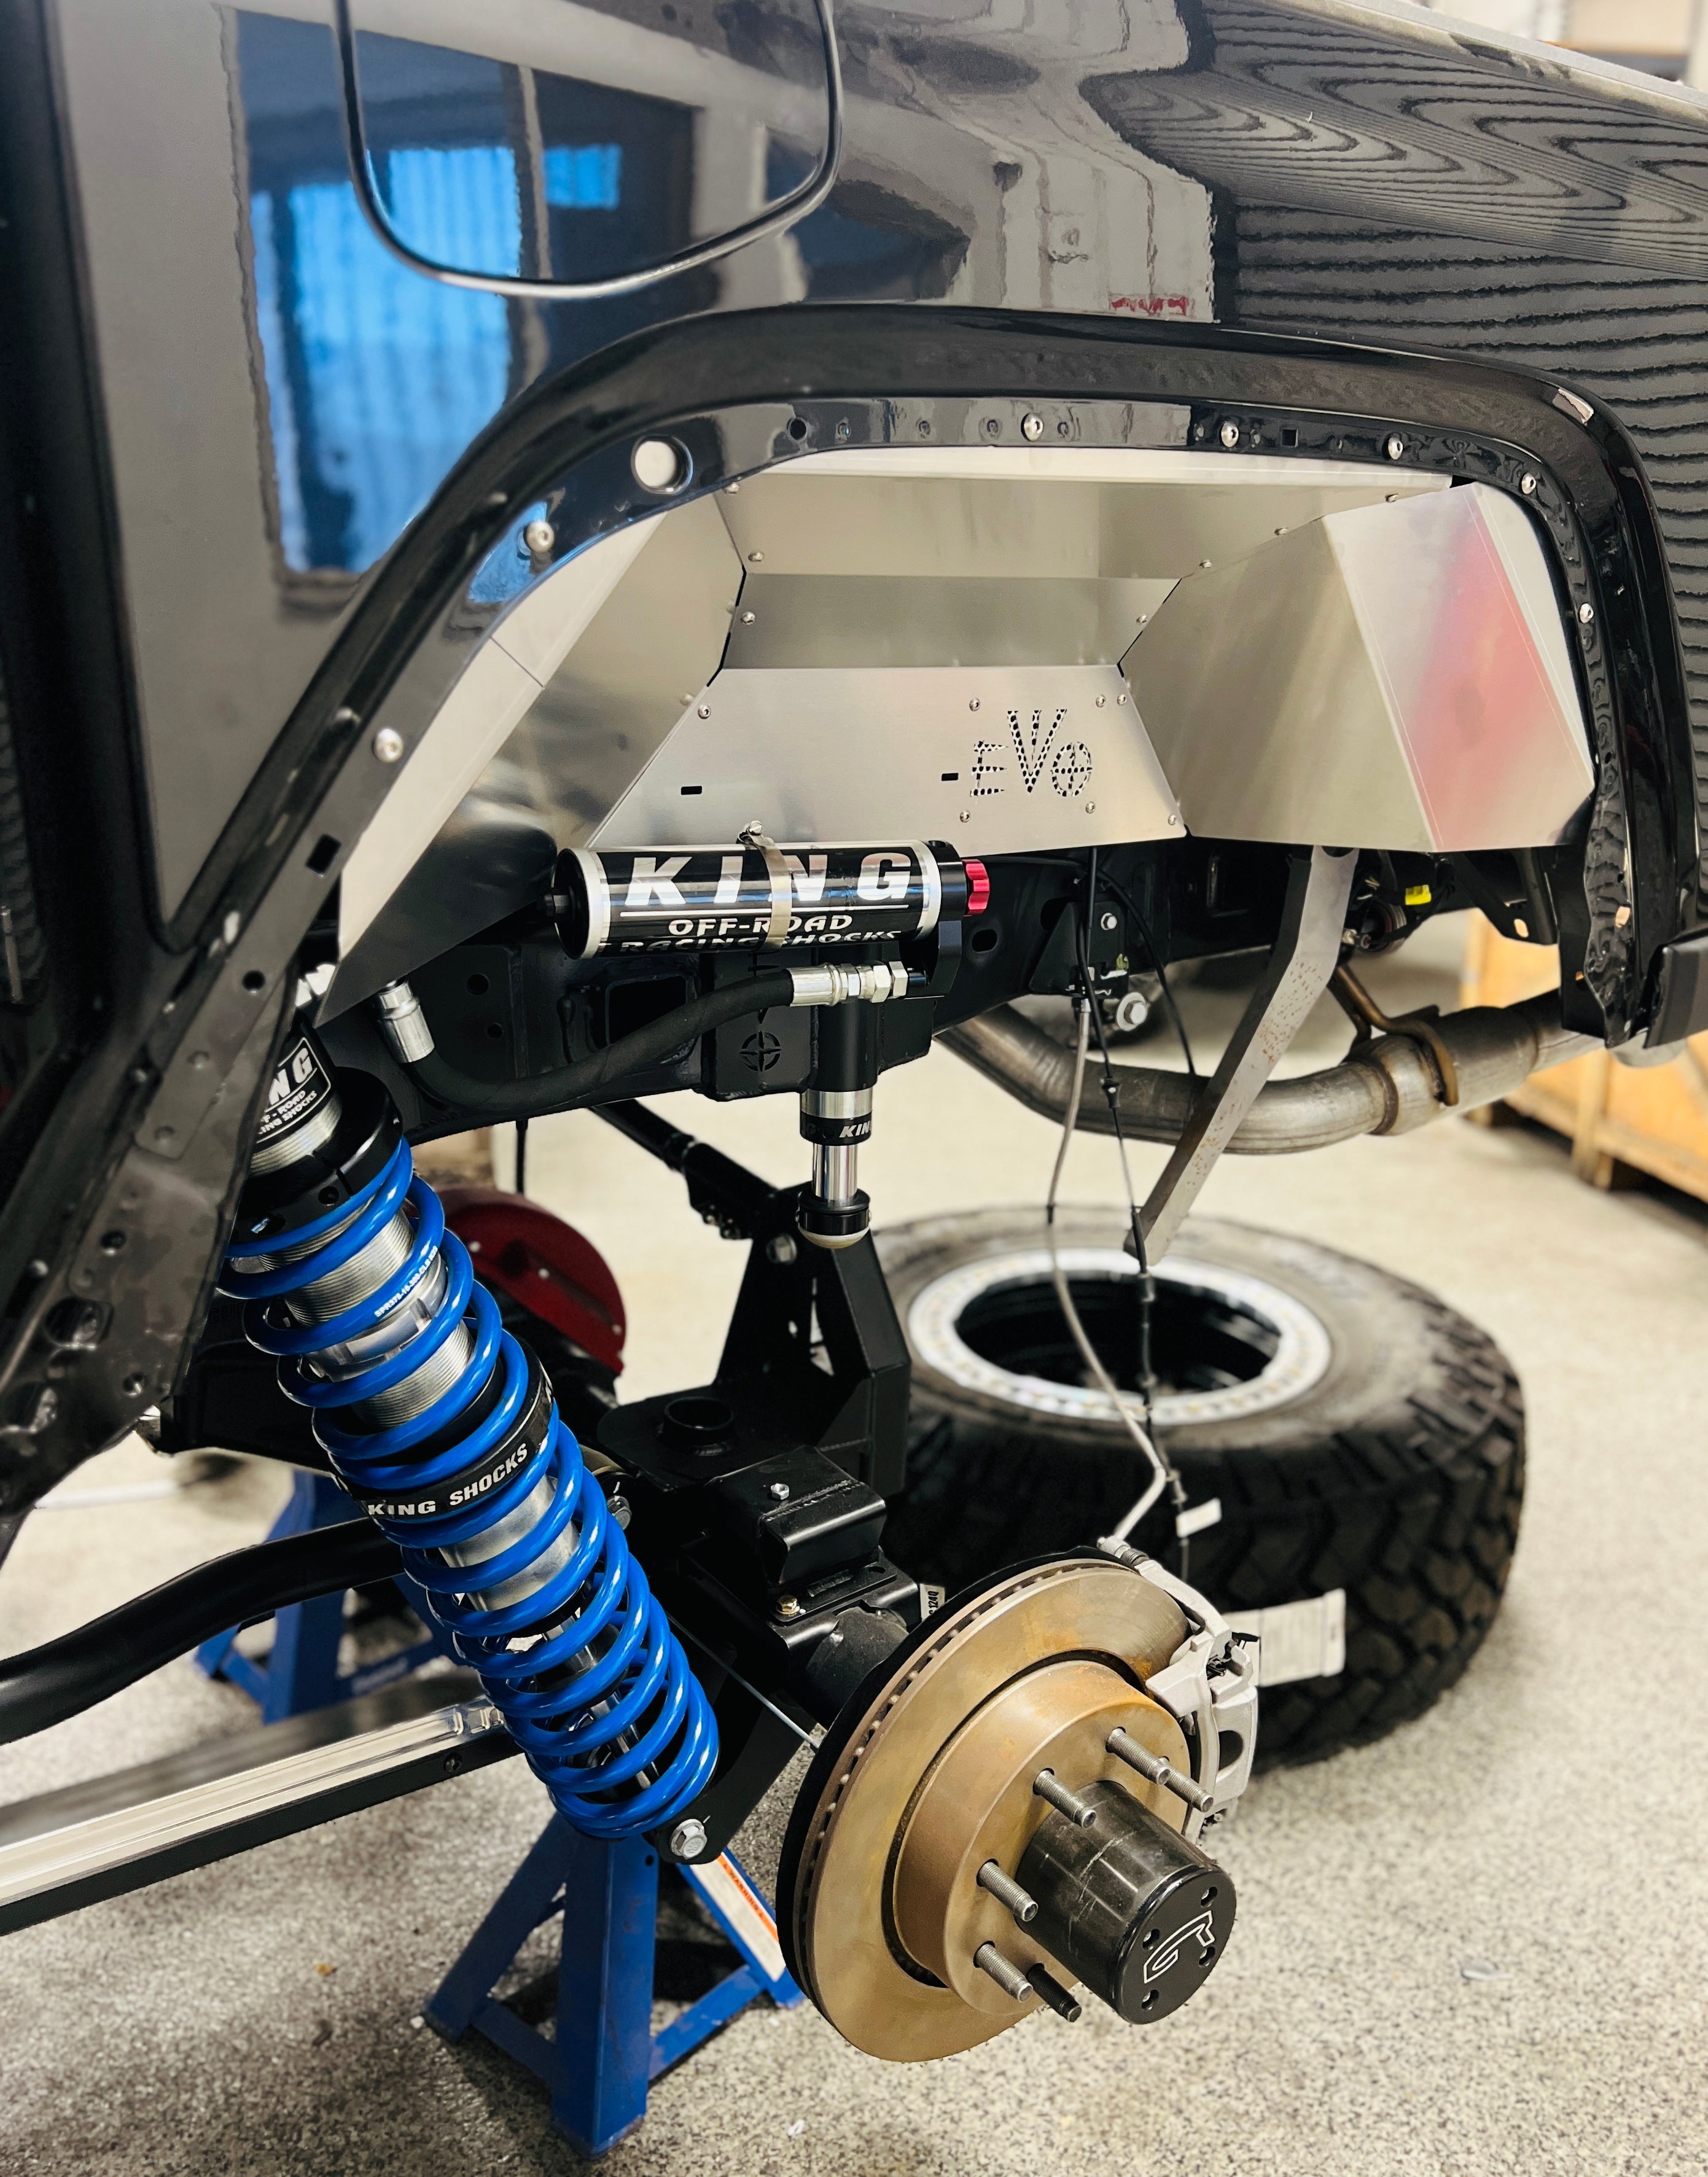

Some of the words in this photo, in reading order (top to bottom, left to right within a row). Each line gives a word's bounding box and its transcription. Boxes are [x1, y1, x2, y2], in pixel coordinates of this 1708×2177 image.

[625, 852, 911, 906] KING
[268, 1047, 313, 1106] NG
[281, 1090, 318, 1121] SHOCKS
[839, 1120, 871, 1138] KIN
[368, 1500, 437, 1516] KING
[449, 1443, 528, 1506] SHOCKS
